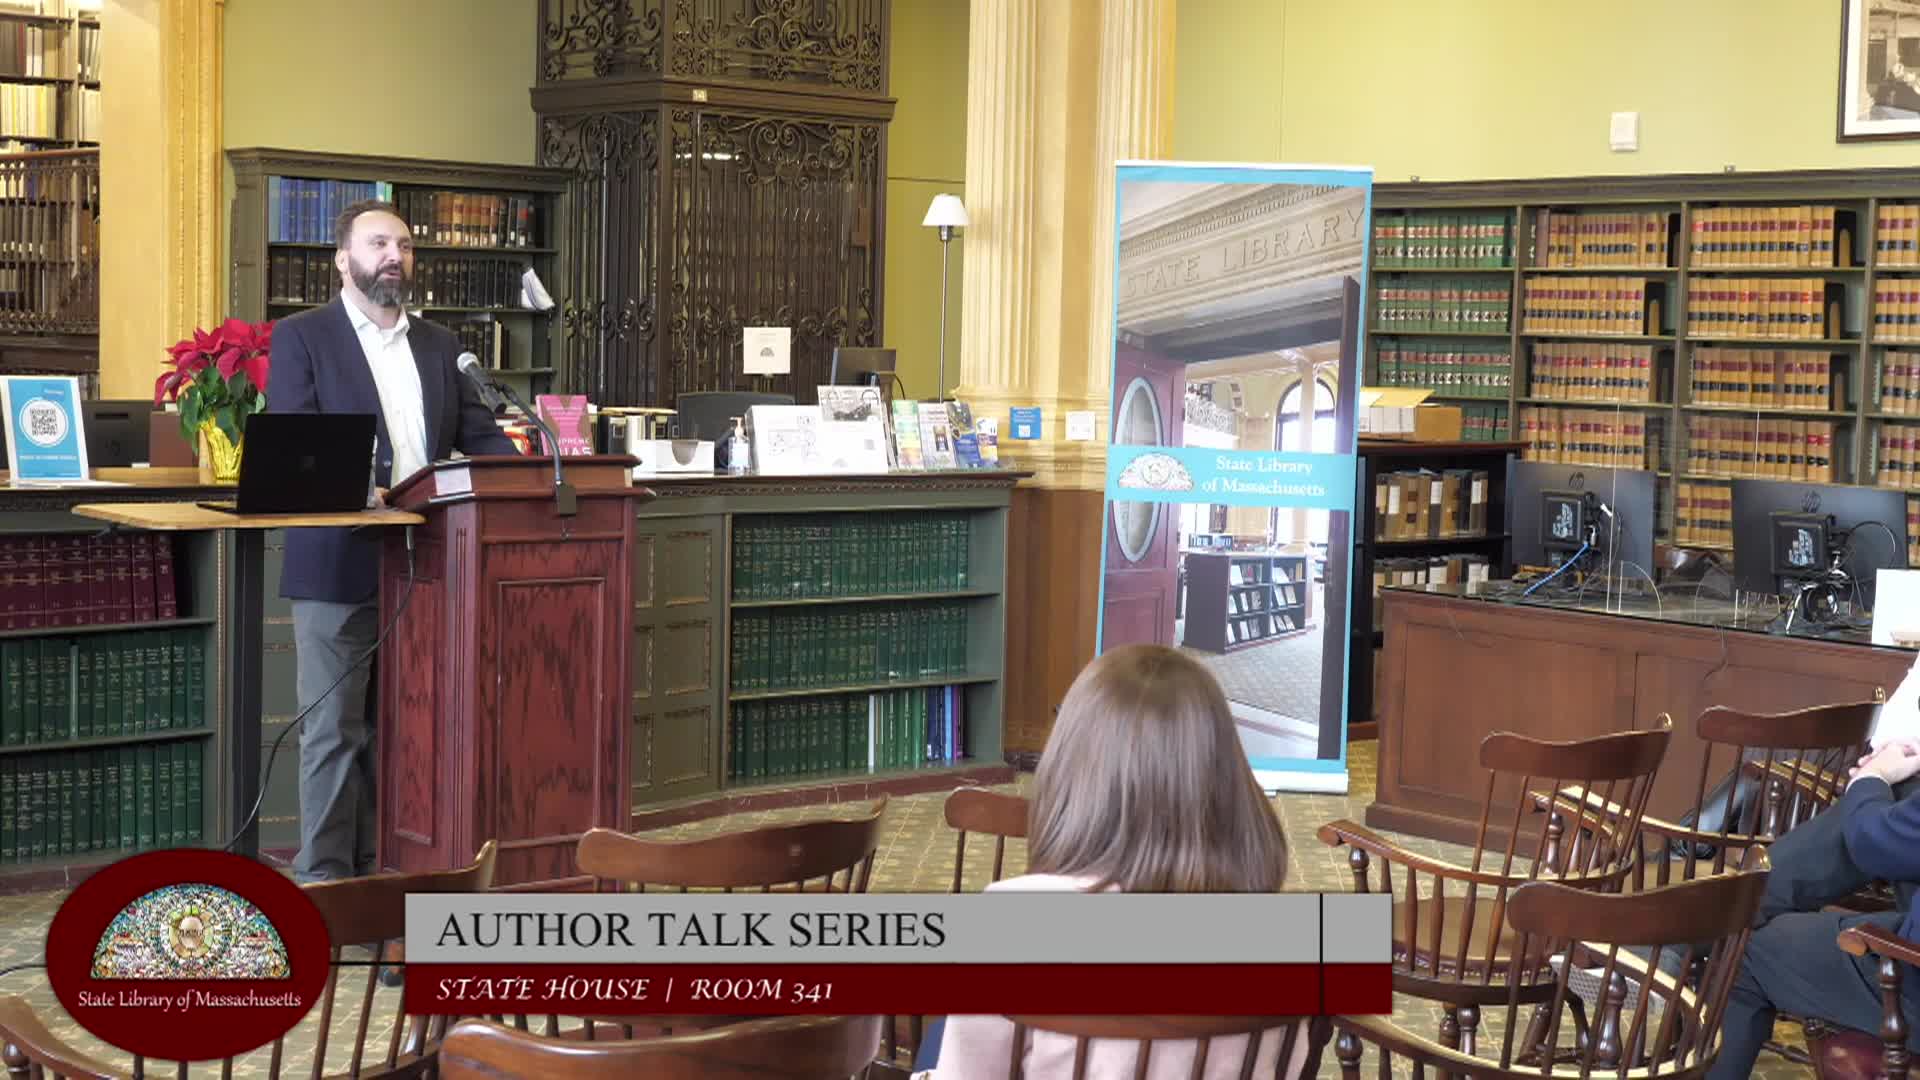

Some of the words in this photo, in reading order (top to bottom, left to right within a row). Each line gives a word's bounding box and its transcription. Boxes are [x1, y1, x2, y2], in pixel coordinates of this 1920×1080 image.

[1125, 255, 1202, 298] STATE
[1222, 206, 1366, 271] LIBRARY
[1216, 455, 1252, 472] State
[1258, 457, 1313, 476] Library
[1202, 477, 1219, 493] of
[1222, 478, 1325, 497] Massachusetts
